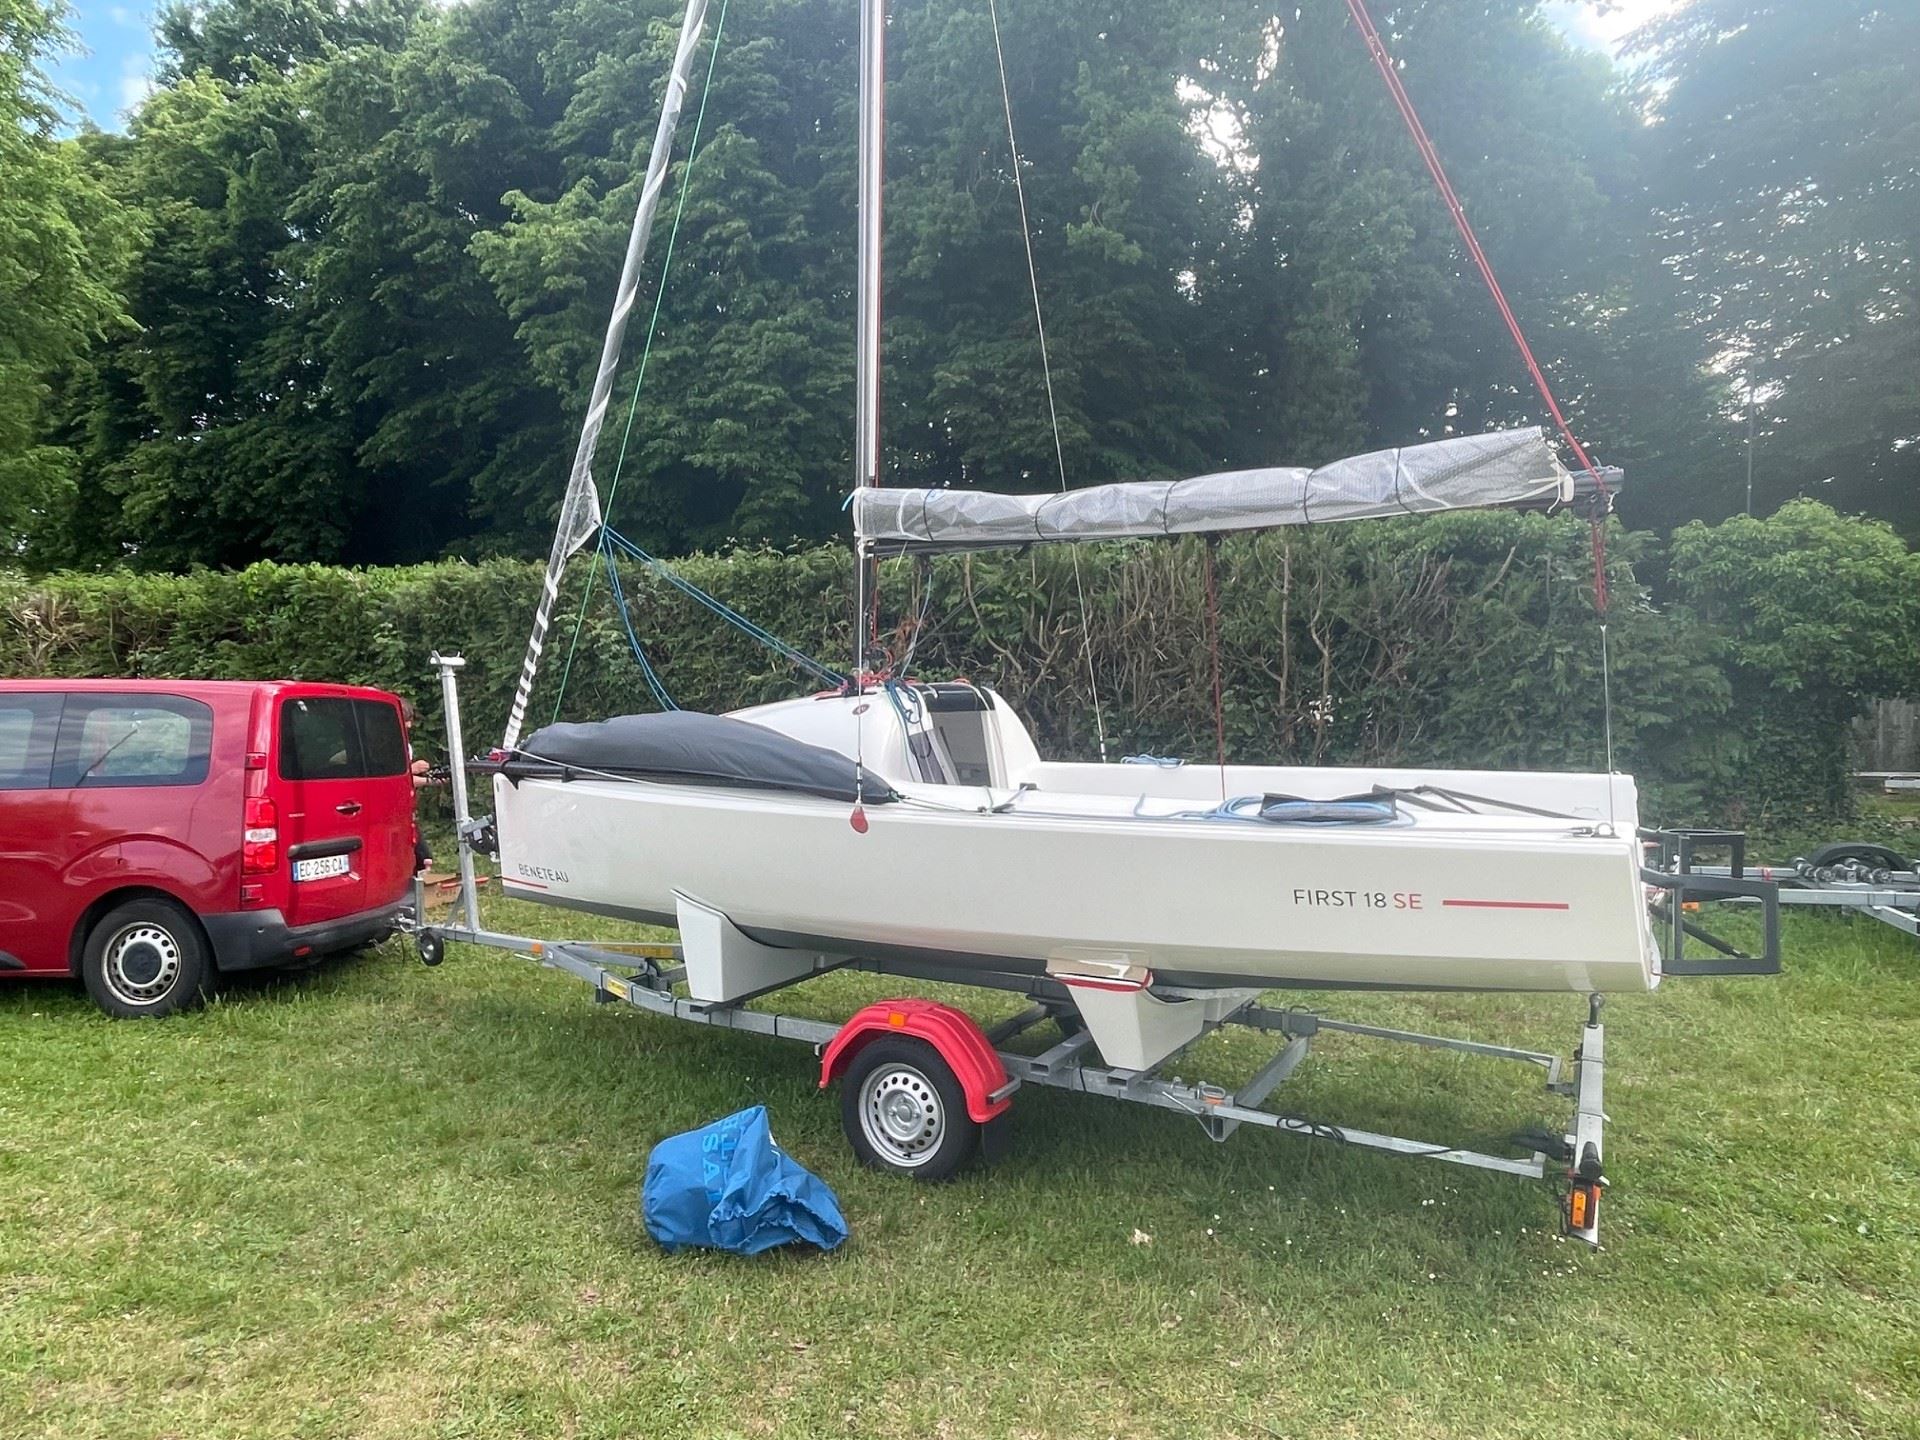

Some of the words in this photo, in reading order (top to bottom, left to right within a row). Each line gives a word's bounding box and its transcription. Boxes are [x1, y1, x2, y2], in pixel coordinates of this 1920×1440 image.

[518, 863, 569, 883] BENETEAU
[1293, 888, 1357, 907] FIRST
[1363, 892, 1387, 908] 18
[1394, 893, 1423, 910] SE
